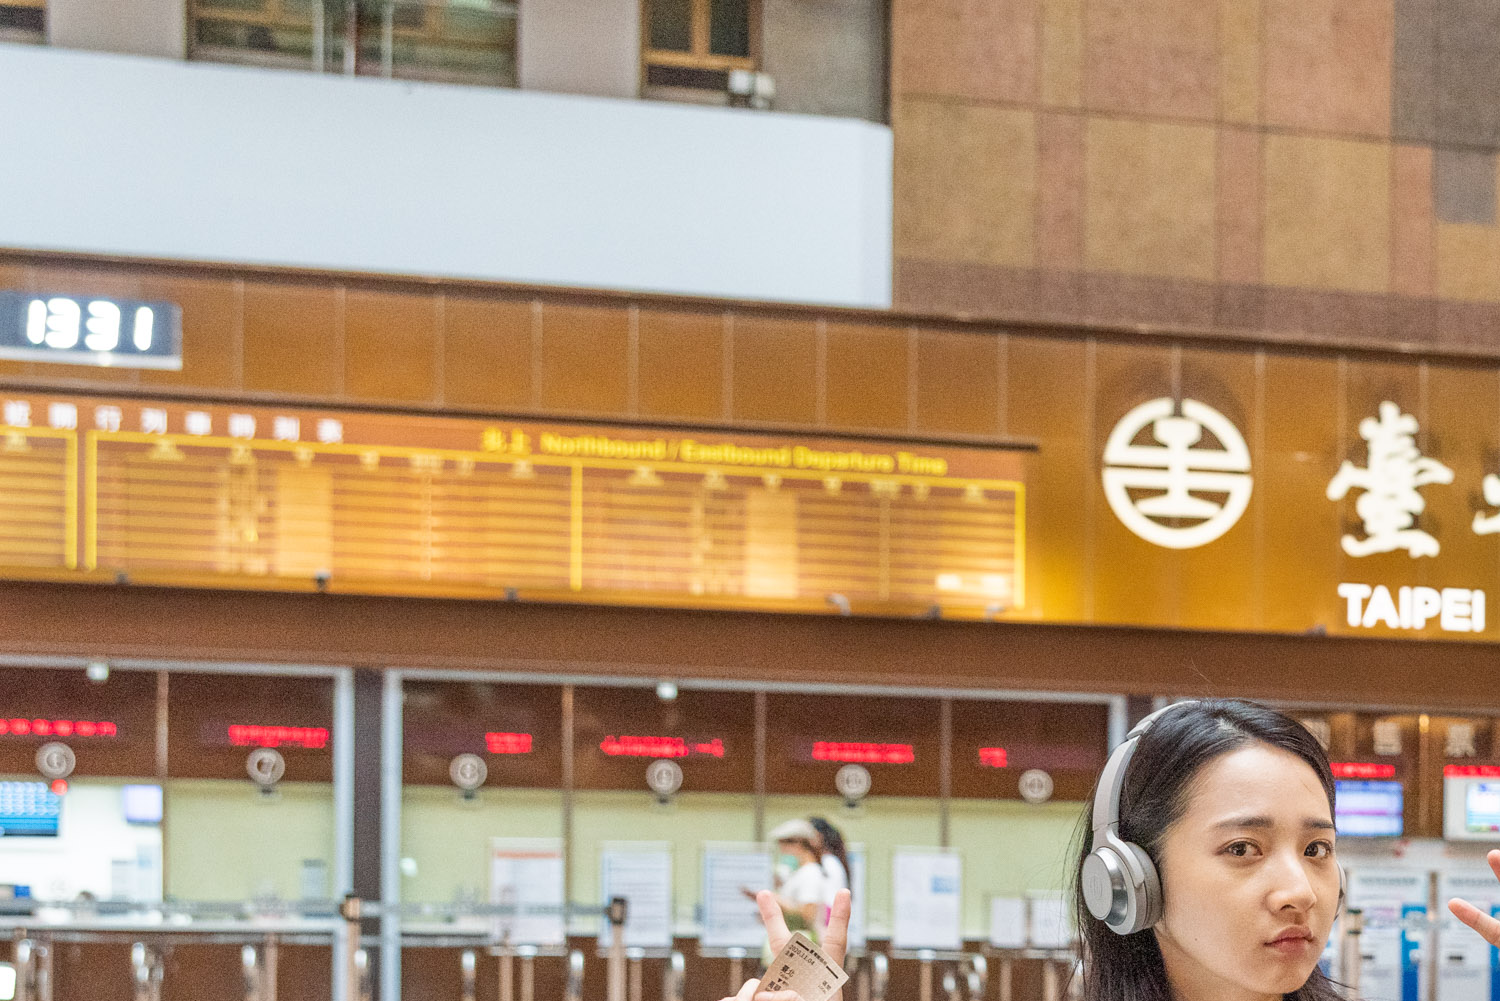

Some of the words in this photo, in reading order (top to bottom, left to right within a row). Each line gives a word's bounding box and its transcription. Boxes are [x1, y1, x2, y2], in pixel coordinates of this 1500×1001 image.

[792, 446, 894, 474] Departure
[897, 452, 948, 477] Time
[1337, 583, 1486, 633] TAIPEI
[788, 944, 815, 966] 2020.11.04
